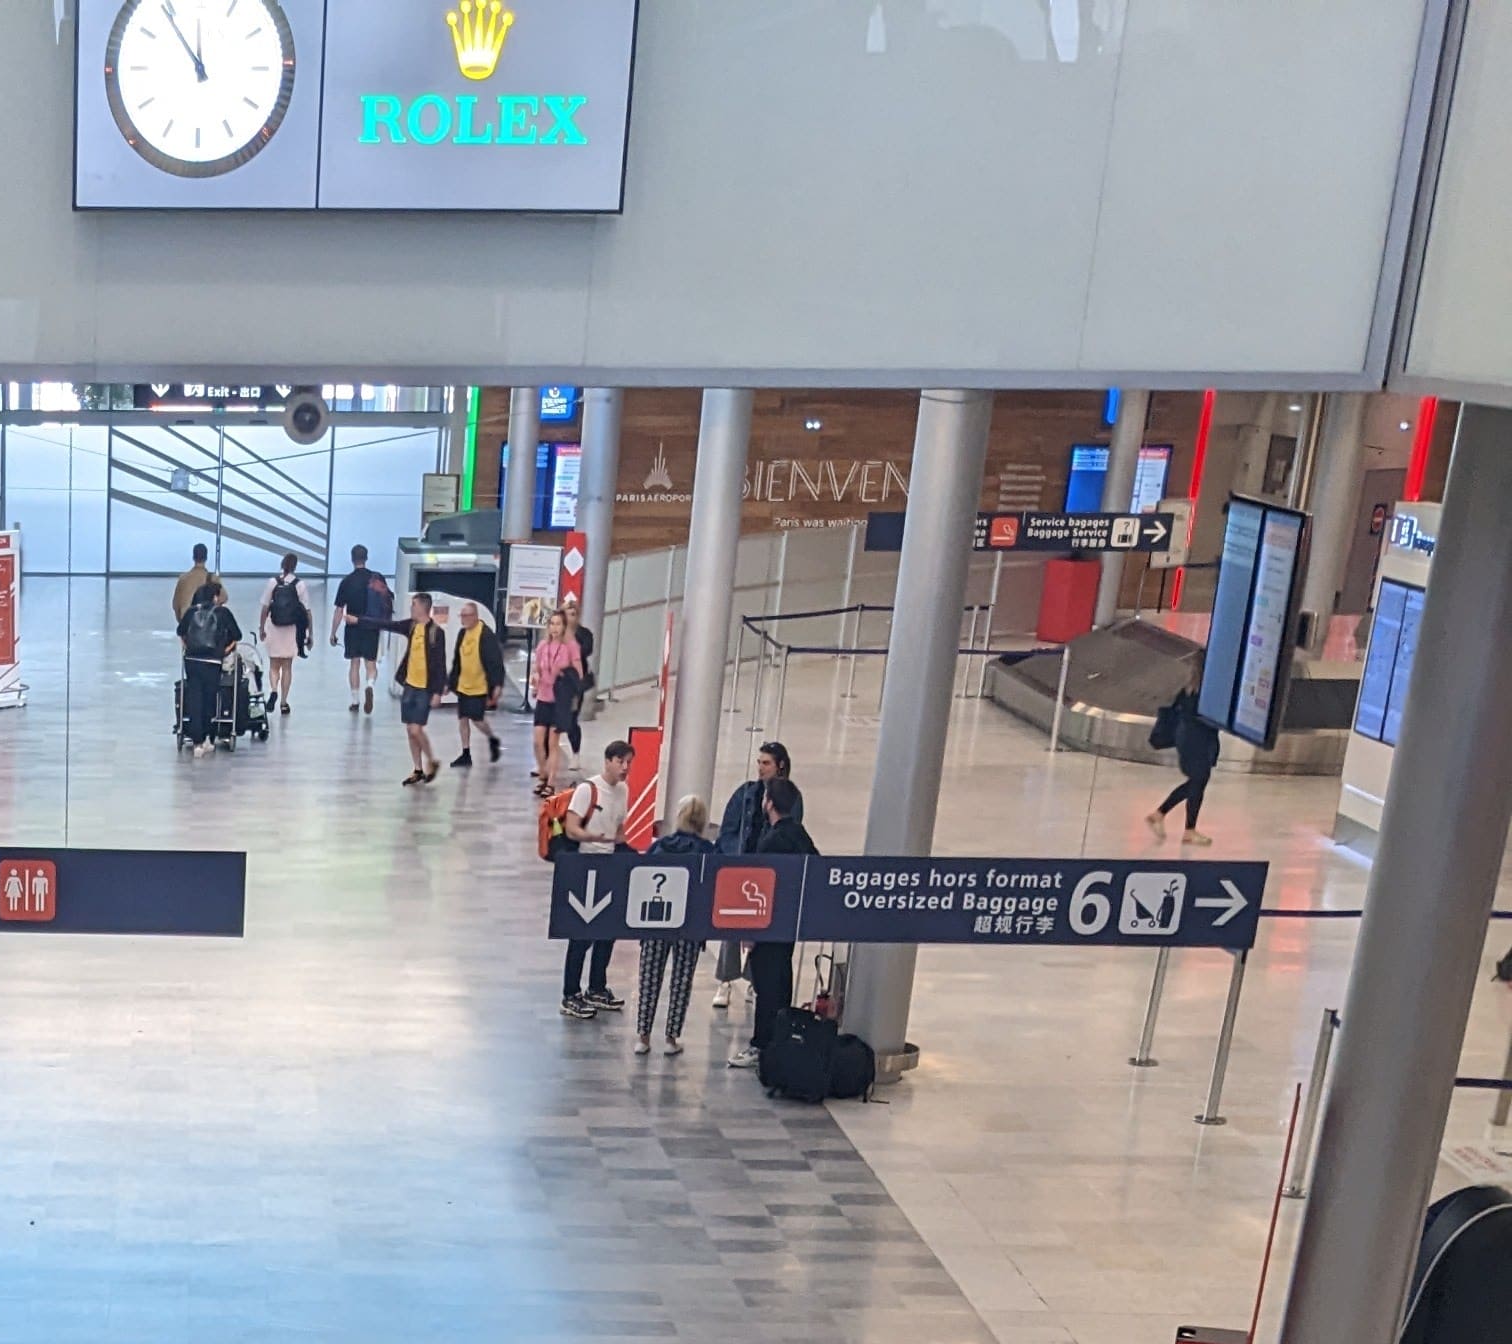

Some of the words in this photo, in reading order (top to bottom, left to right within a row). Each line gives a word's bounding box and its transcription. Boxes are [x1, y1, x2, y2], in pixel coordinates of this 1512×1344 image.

[359, 94, 588, 145] ROLEX
[207, 386, 230, 398] Exit
[742, 460, 910, 503] IENVEN
[775, 516, 800, 528] Paris
[803, 519, 824, 528] was
[1030, 517, 1066, 527] Service
[1069, 517, 1110, 529] bagages
[1027, 527, 1070, 539] Baggage
[1072, 527, 1108, 538] Service
[828, 868, 921, 891] Bagages
[929, 869, 978, 888] hors
[986, 869, 1063, 889] format
[844, 891, 954, 910] Oversized
[962, 893, 1059, 915] Baggage
[1068, 870, 1114, 936] 6
[973, 916, 1056, 935] 超规行李
